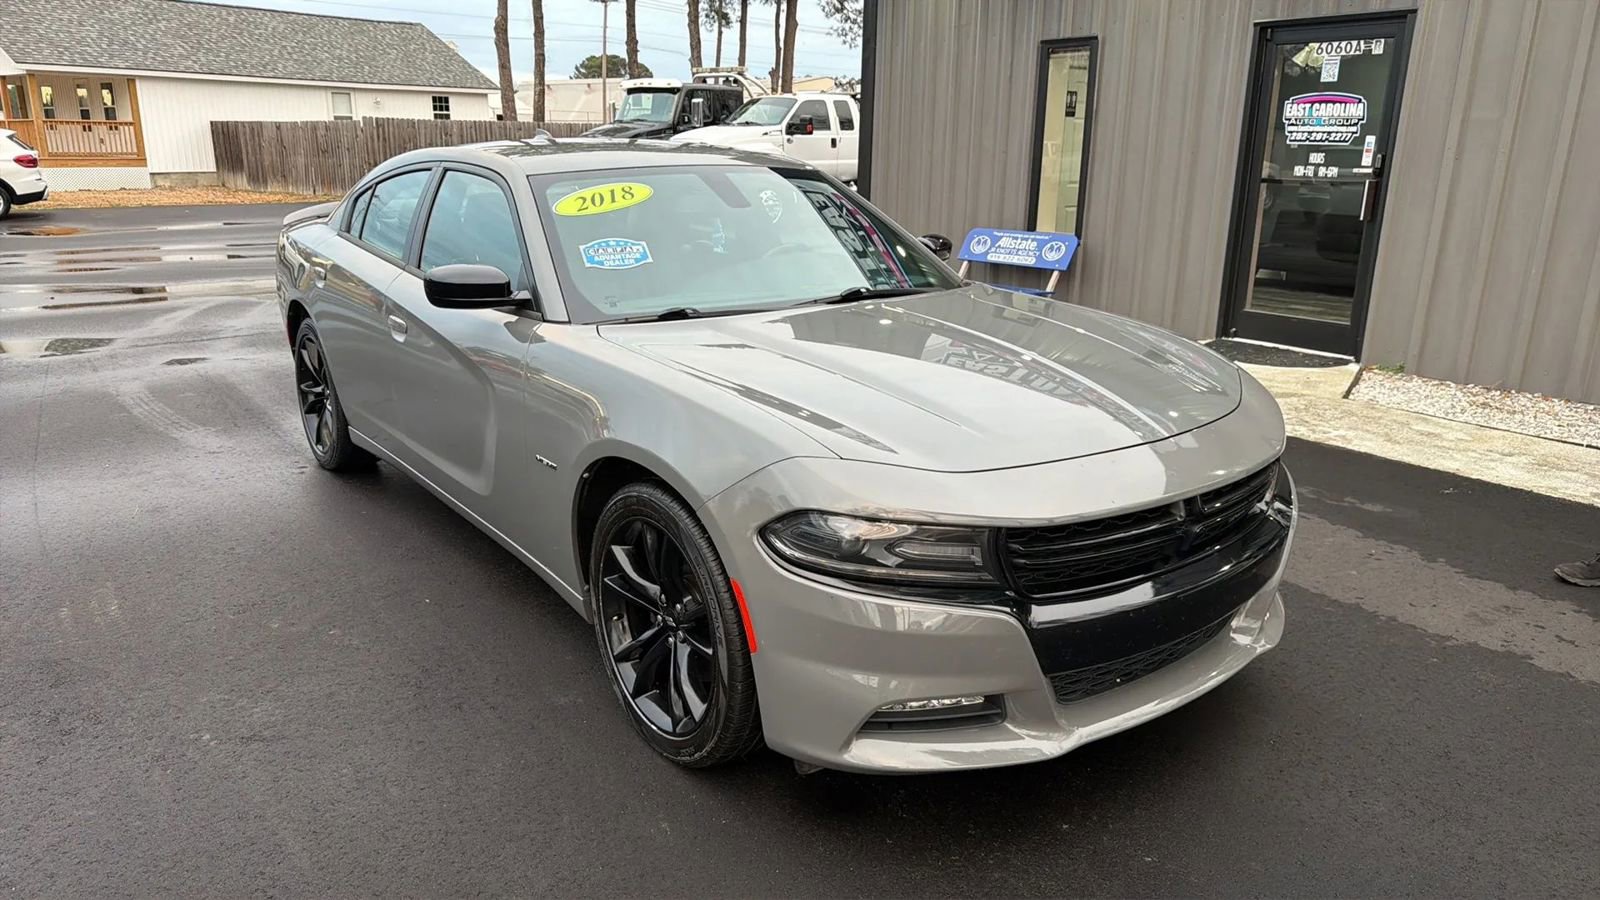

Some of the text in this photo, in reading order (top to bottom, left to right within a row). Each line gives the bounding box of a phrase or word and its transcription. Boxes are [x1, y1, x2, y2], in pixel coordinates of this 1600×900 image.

[1286, 103, 1364, 117] EAST CAROLINA
[574, 187, 634, 211] 2018
[594, 253, 641, 262] ADVANTAGE
[603, 259, 636, 267] DEALER
